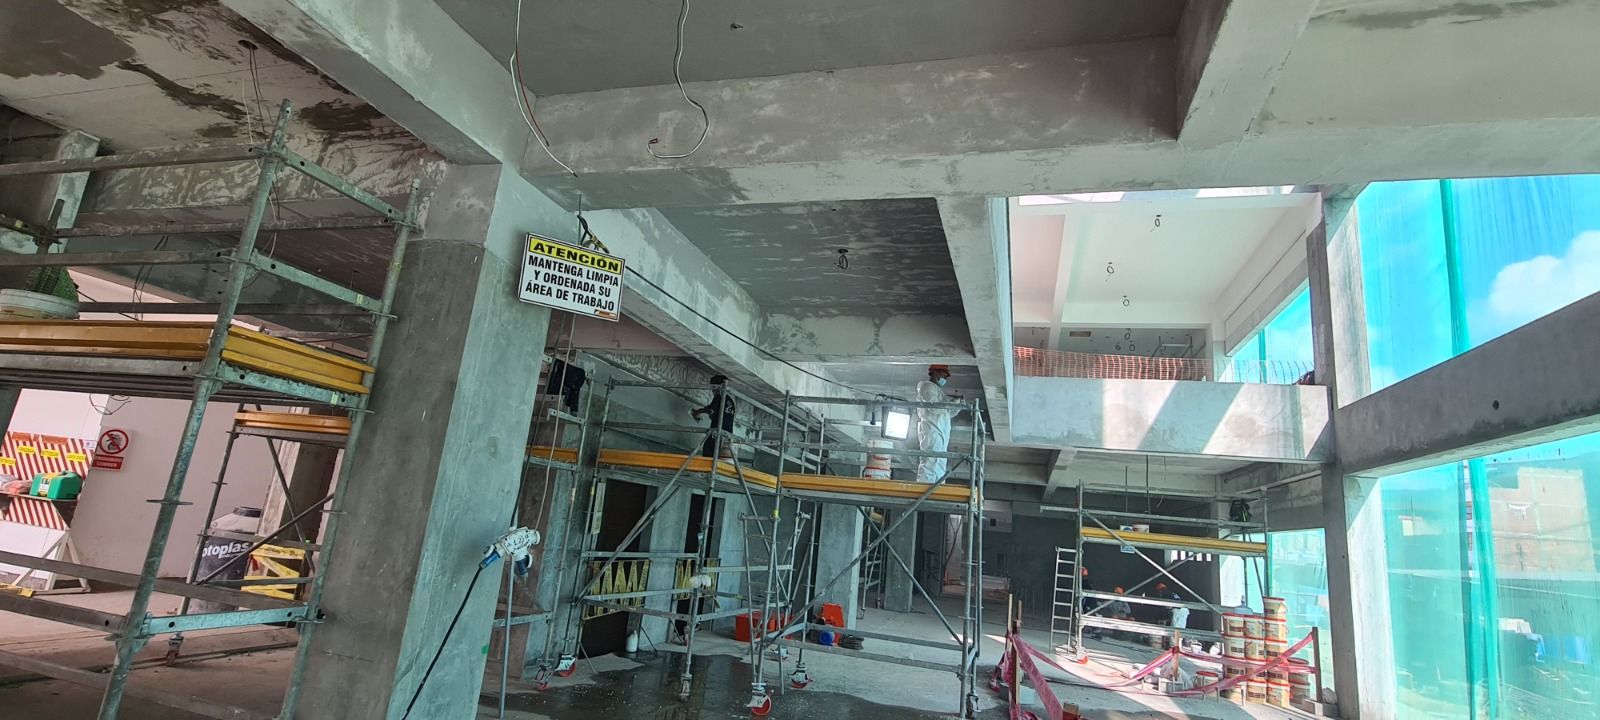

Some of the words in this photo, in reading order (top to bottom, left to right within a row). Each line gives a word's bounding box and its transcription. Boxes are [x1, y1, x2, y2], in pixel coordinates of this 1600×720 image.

[528, 255, 583, 278] MANTENGA
[586, 270, 619, 287] LIMPIA
[534, 242, 619, 272] ATENCIÓN
[526, 280, 552, 298] ÁREA
[556, 289, 569, 300] DE
[572, 292, 614, 311] TRABAJO
[534, 270, 542, 280] Y
[544, 272, 596, 294] ORDENADA
[598, 286, 611, 298] SU
